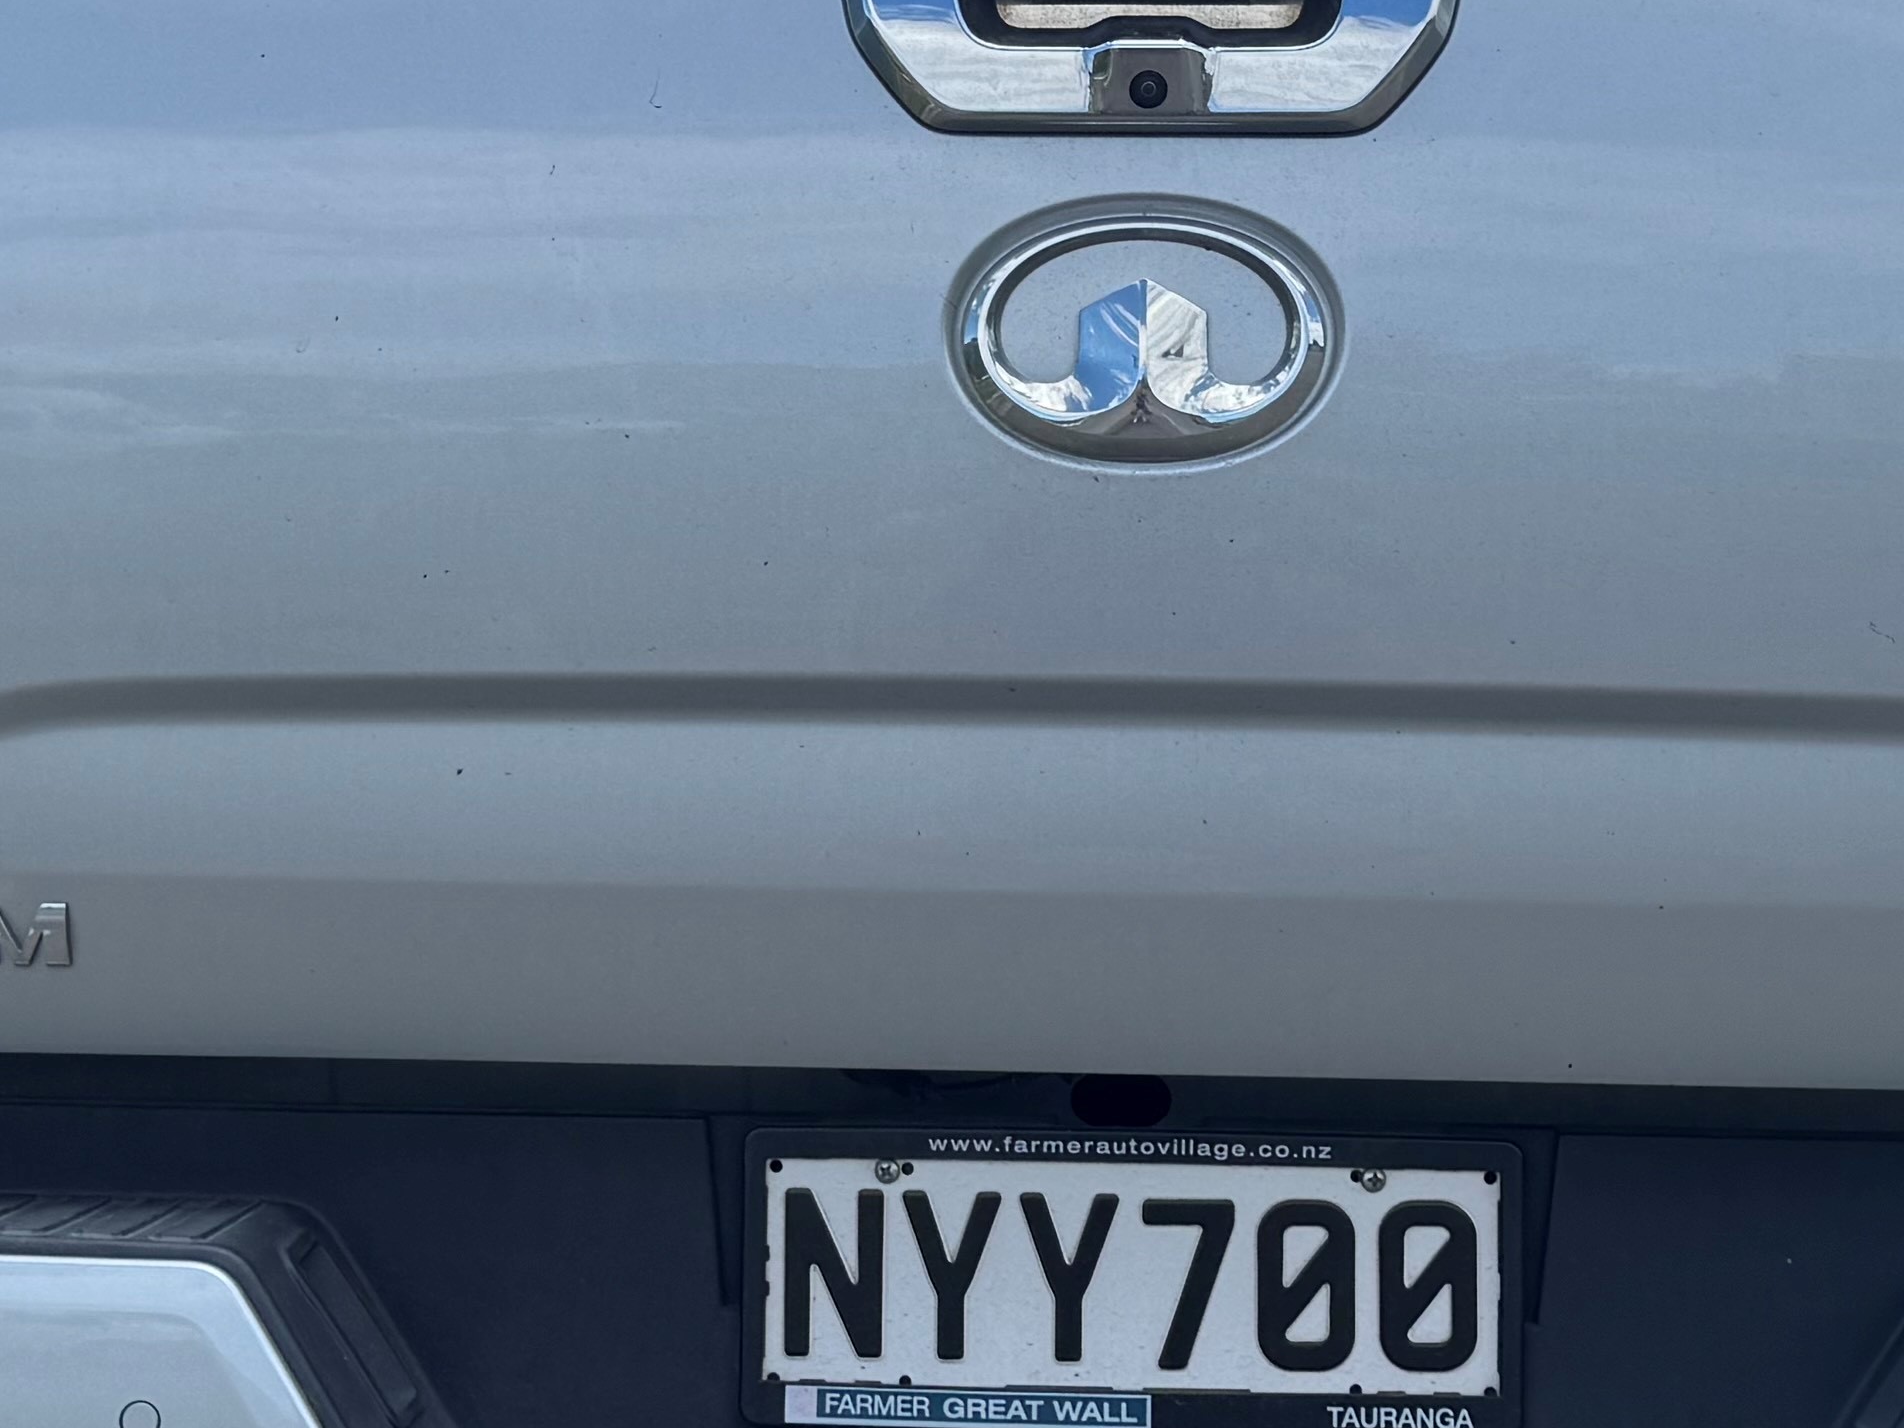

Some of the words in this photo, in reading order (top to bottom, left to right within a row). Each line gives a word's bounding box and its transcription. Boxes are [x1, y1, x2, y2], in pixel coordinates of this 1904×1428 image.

[928, 1135, 1333, 1161] www.farmerautovillage.co.nz
[783, 1186, 1479, 1373] NYY700
[824, 1392, 931, 1418] FARMER
[942, 1396, 1045, 1421] GREAT
[1052, 1400, 1139, 1425] WALL
